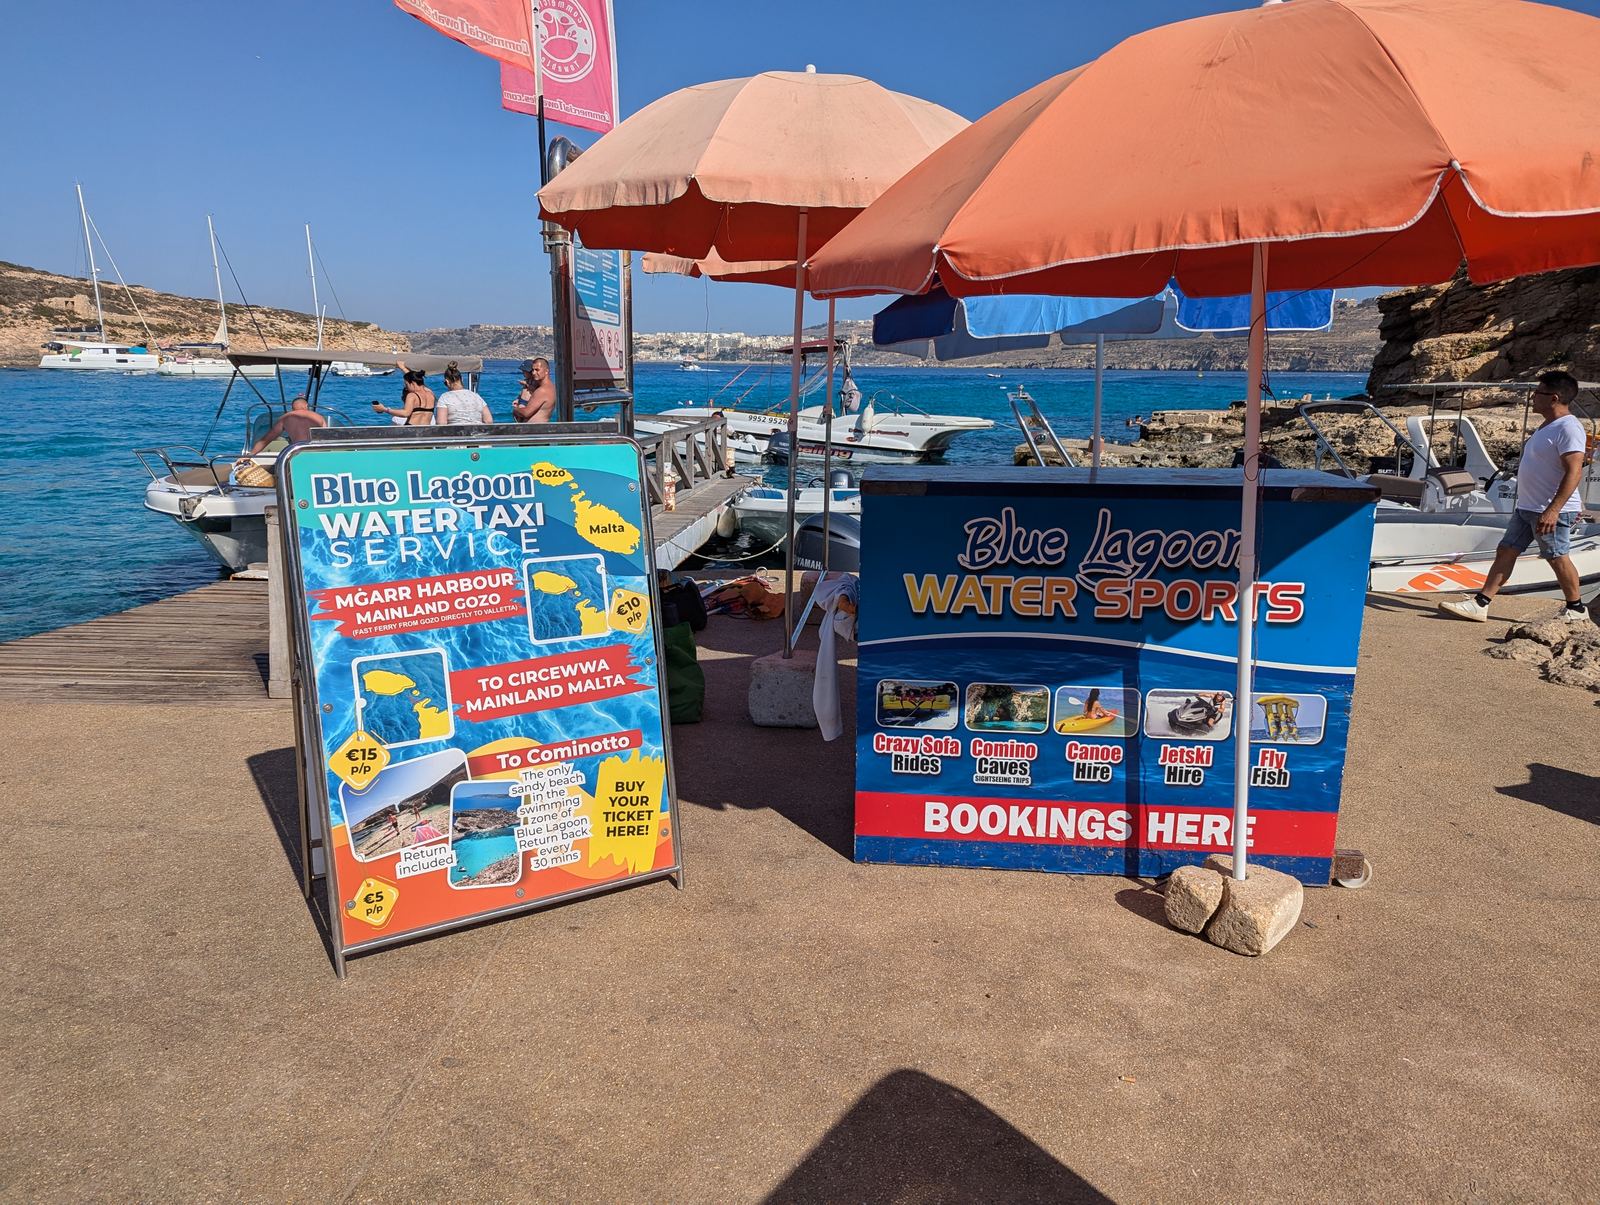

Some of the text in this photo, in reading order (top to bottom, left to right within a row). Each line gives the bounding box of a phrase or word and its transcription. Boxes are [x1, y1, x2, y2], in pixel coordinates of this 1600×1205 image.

[748, 414, 766, 423] 9952
[536, 469, 566, 478] Gozo
[311, 471, 535, 508] Blue Lagoon
[318, 502, 545, 539] WATER TAXI
[589, 523, 625, 534] Malta
[330, 529, 540, 568] SERVICE
[957, 507, 1068, 570] Blue
[417, 573, 514, 598] HARBOUR
[903, 573, 1078, 616] WATER
[356, 593, 501, 625] MAINLAND GOZO
[616, 597, 641, 616] €10
[352, 605, 518, 637] (FAST FERRY FROM GOZO DIRECTLY TO VALLETTA)
[626, 611, 642, 625] p/p
[478, 658, 610, 692] TO CIRCEWWA
[466, 674, 626, 713] MAINLAND MALTA
[345, 748, 378, 761] €15
[496, 735, 630, 769] To Cominotto
[874, 734, 961, 757] Crazy Sofa
[970, 739, 1038, 760] Comino
[1065, 741, 1123, 763] Canoe
[1159, 744, 1213, 767] Jetski
[351, 762, 371, 775] p/p
[892, 754, 941, 774] Rides
[977, 758, 1030, 776] Caves
[1258, 748, 1287, 769] Fly
[522, 764, 571, 781] The only
[975, 775, 1030, 784] SIGHTSEEING TRIPS
[1074, 762, 1112, 782] Hire
[1165, 765, 1204, 785] Hire
[1251, 767, 1289, 787] Fish
[511, 773, 584, 795] sandy beach
[615, 781, 645, 792] BUY
[533, 788, 566, 802] in the
[608, 795, 649, 807] YOUR
[519, 797, 580, 816] swimming
[531, 807, 573, 824] zone of
[602, 810, 654, 822] TICKET
[516, 817, 588, 839] Blue Lagoon
[606, 825, 649, 837] HERE!
[924, 801, 1132, 842] BOOKINGS
[519, 827, 588, 849] Return back
[404, 846, 447, 862] Return
[539, 842, 570, 856] every
[399, 854, 454, 875] included
[533, 852, 579, 869] 30 mins
[363, 891, 384, 904] €5
[366, 904, 383, 916] p/p
